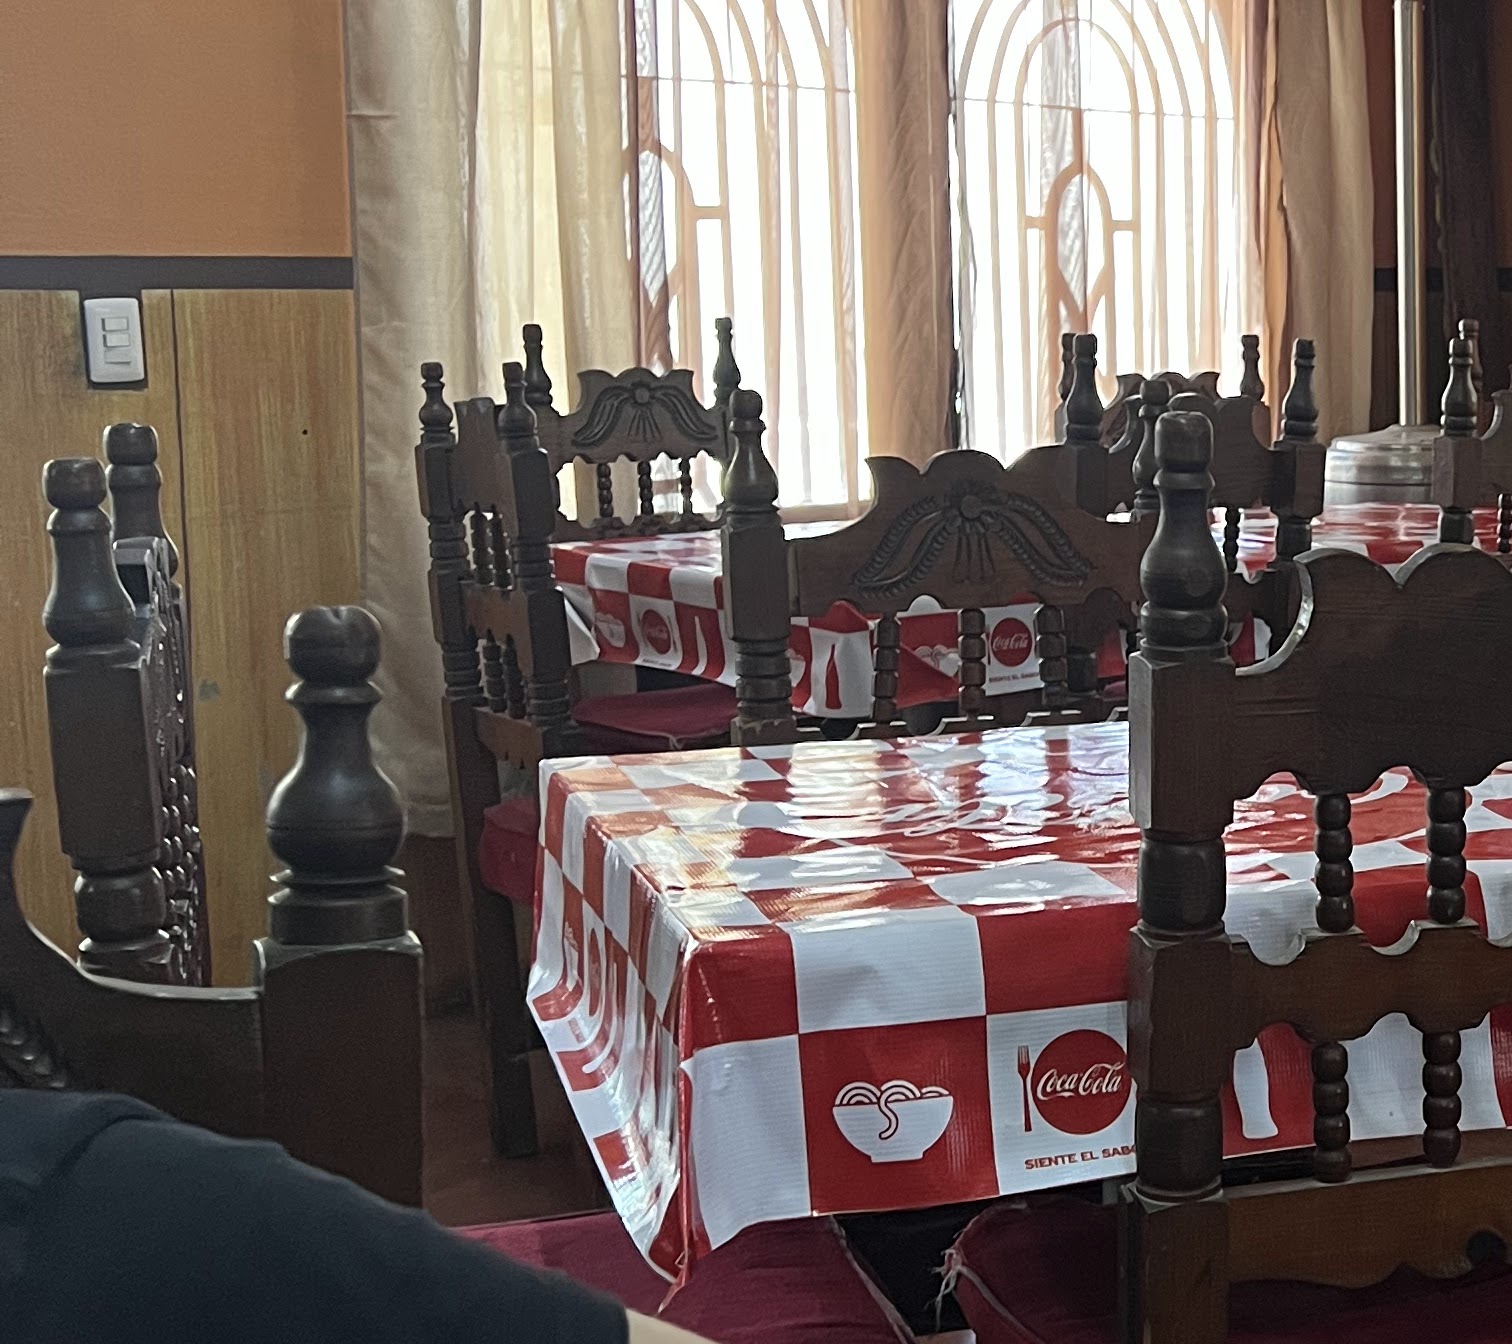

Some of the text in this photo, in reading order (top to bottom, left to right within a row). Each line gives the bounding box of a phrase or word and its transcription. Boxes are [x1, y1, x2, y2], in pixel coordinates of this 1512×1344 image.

[1037, 1061, 1125, 1100] Coca-Cola
[1024, 1153, 1077, 1170] SIENTE
[1081, 1151, 1099, 1162] EL
